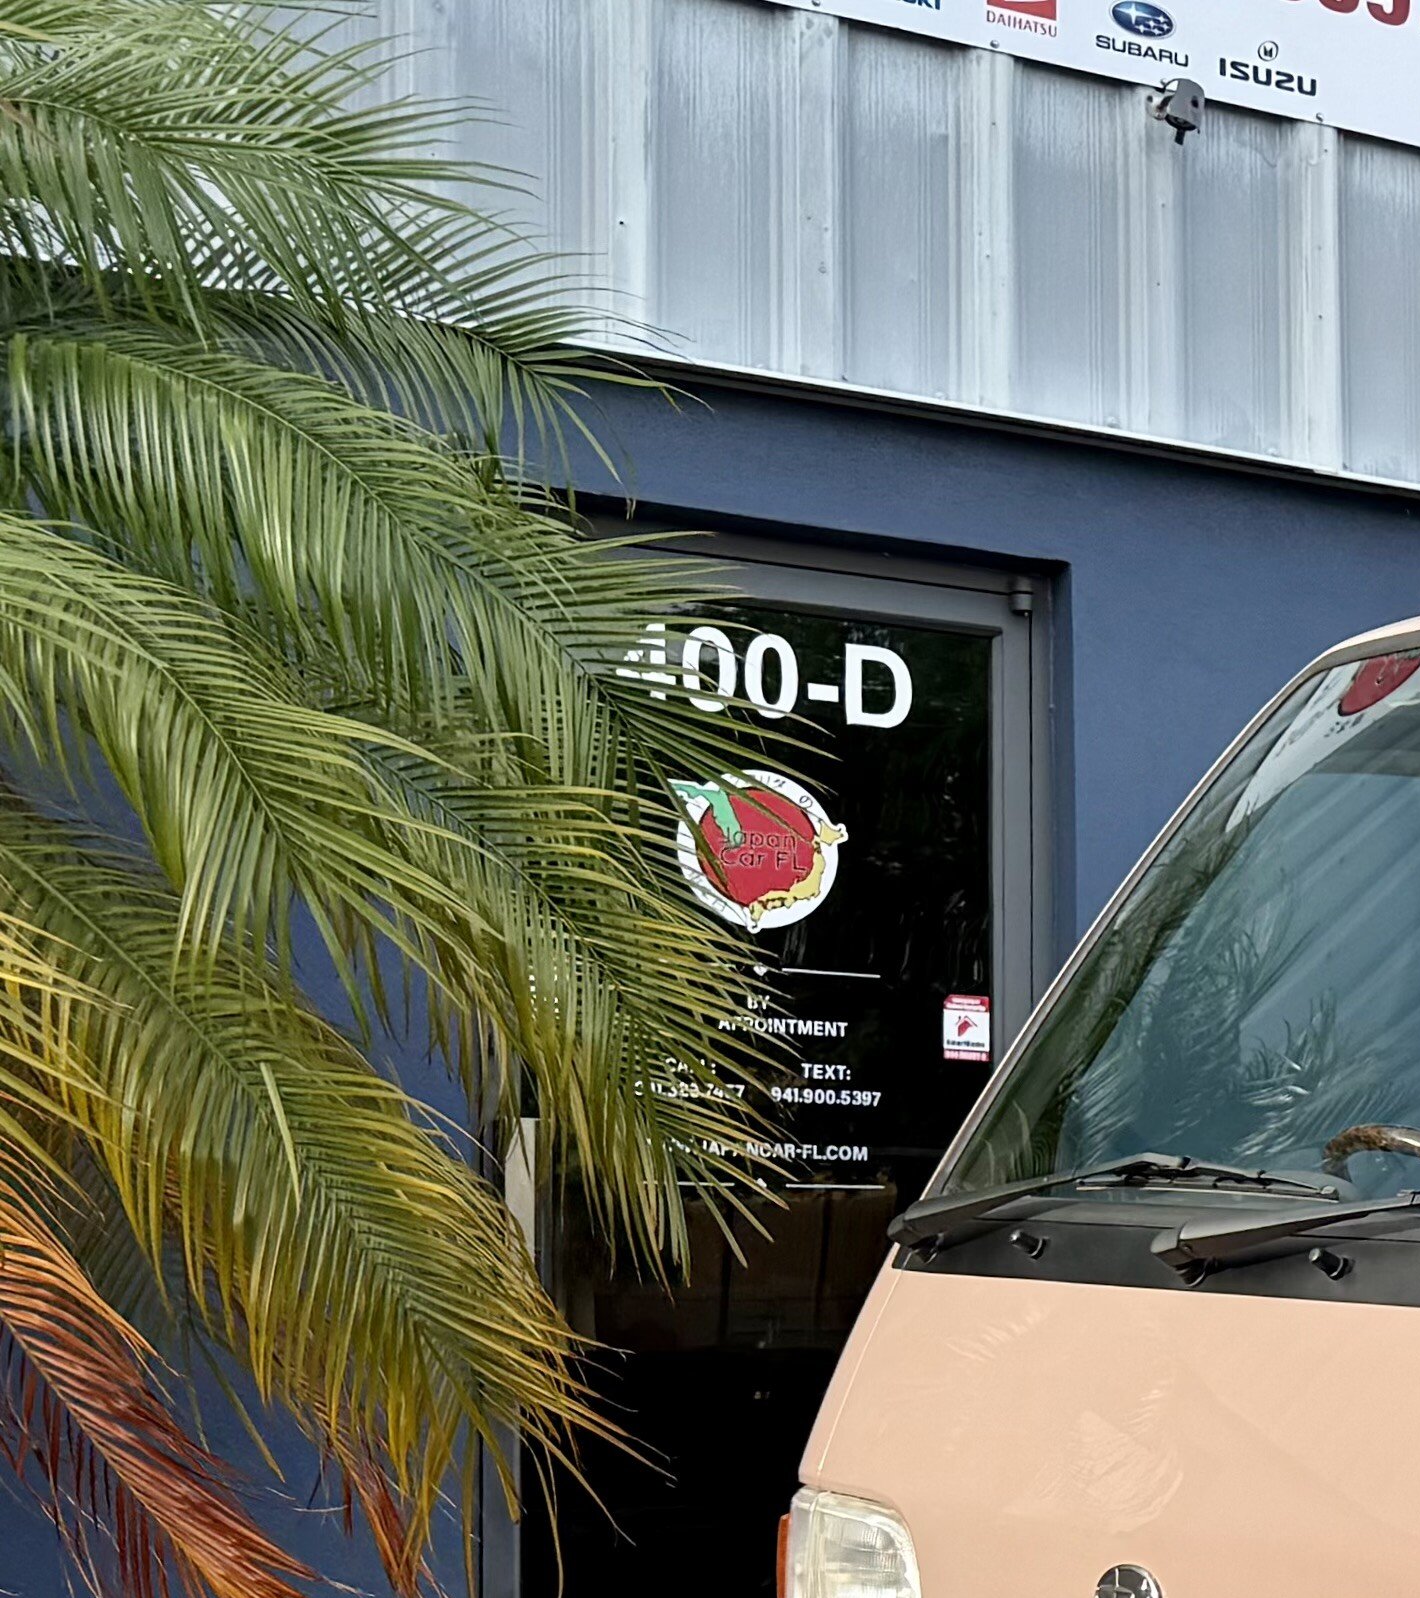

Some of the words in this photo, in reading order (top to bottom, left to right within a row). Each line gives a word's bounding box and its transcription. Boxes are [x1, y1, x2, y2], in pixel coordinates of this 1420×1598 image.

[986, 10, 1058, 38] DAIHATSU
[1095, 34, 1189, 67] SUBARU
[1219, 57, 1317, 97] ISUZU
[720, 826, 797, 850] Japan
[719, 846, 765, 867] Car
[776, 851, 807, 872] FL
[802, 1062, 851, 1081] TEXT:
[771, 1086, 881, 1106] 941.900.5397
